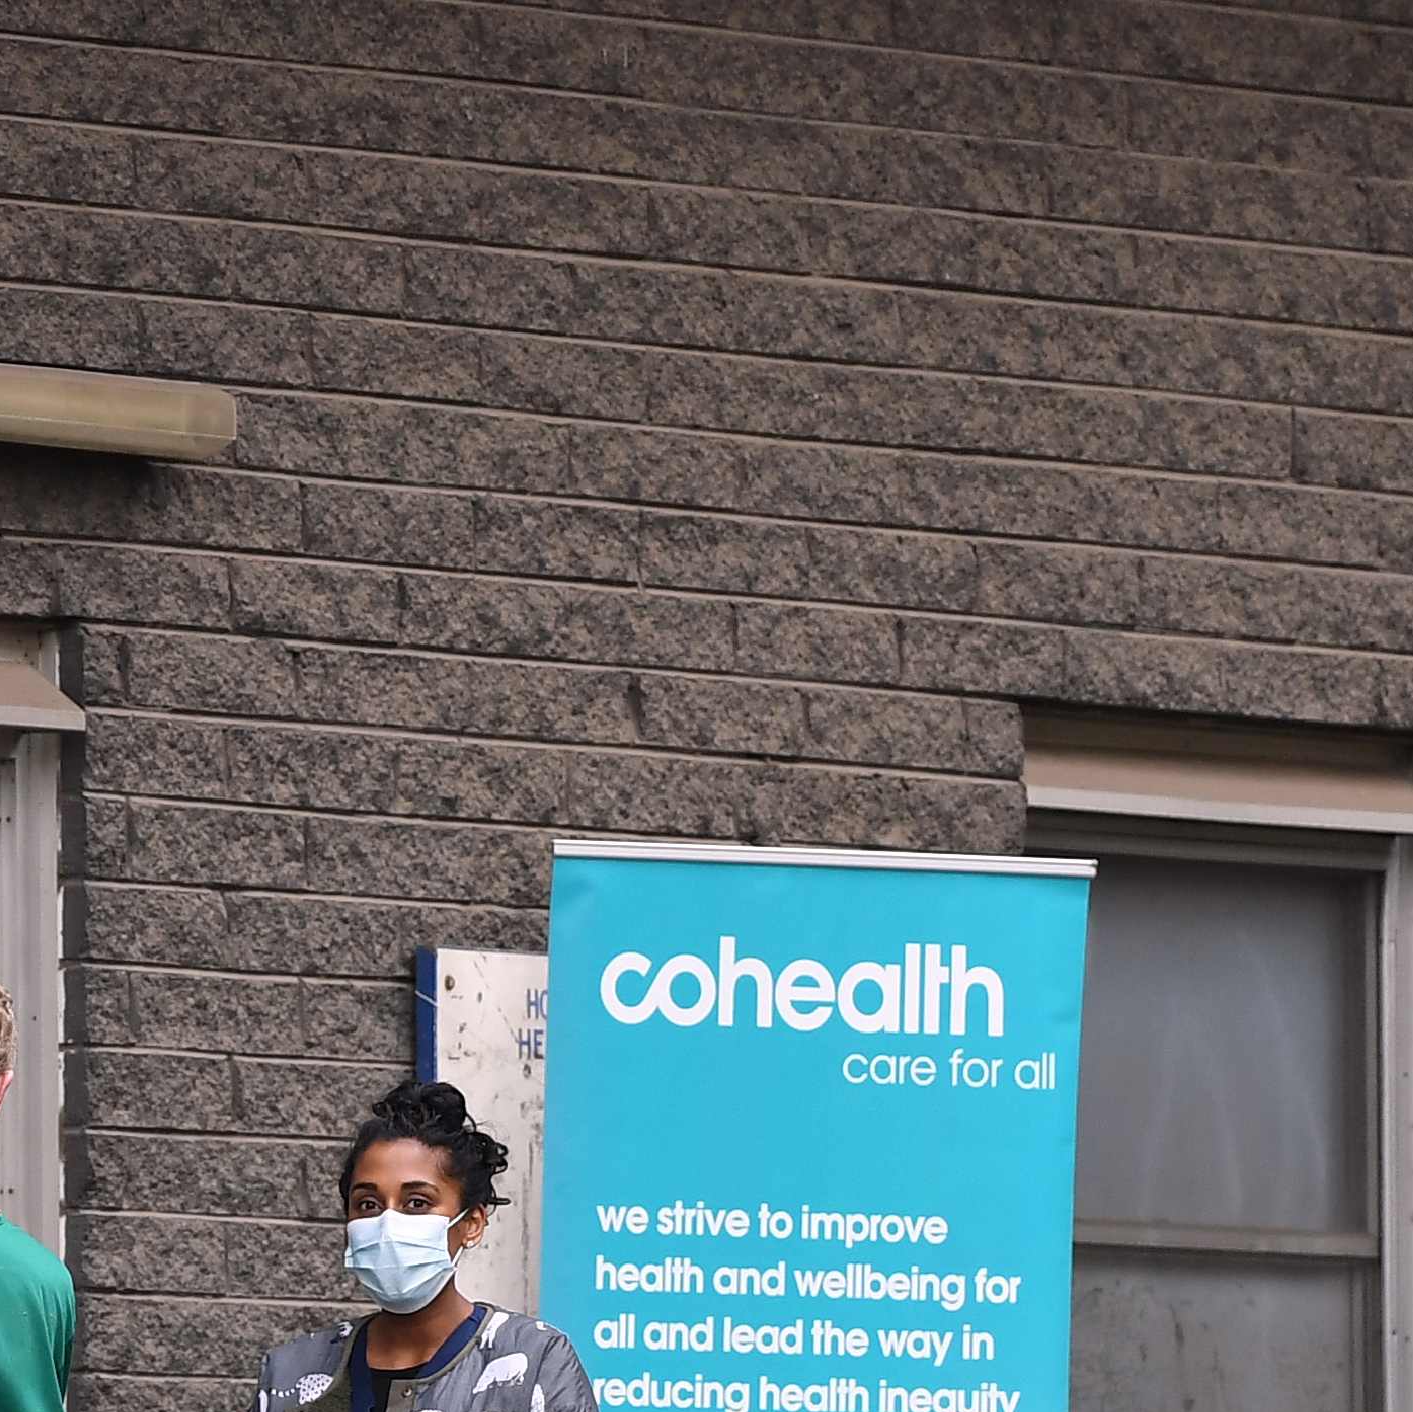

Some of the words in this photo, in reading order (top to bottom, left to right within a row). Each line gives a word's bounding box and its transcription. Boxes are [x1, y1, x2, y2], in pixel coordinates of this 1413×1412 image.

[601, 936, 1004, 1037] cohealth
[843, 1055, 936, 1085] care
[950, 1049, 1003, 1087] for
[1015, 1053, 1055, 1089] all
[597, 1206, 648, 1233] we
[657, 1201, 750, 1237] strive
[759, 1204, 793, 1238] to
[802, 1205, 948, 1248] improve
[596, 1255, 703, 1293] health
[713, 1261, 785, 1296] and
[795, 1263, 965, 1311] wellbeing
[975, 1268, 1021, 1303] for
[594, 1314, 635, 1348] all
[644, 1317, 713, 1351] and
[724, 1317, 803, 1354] lead
[811, 1320, 869, 1357] the
[878, 1330, 952, 1366] way
[963, 1325, 994, 1360] in
[760, 1376, 869, 1412] health
